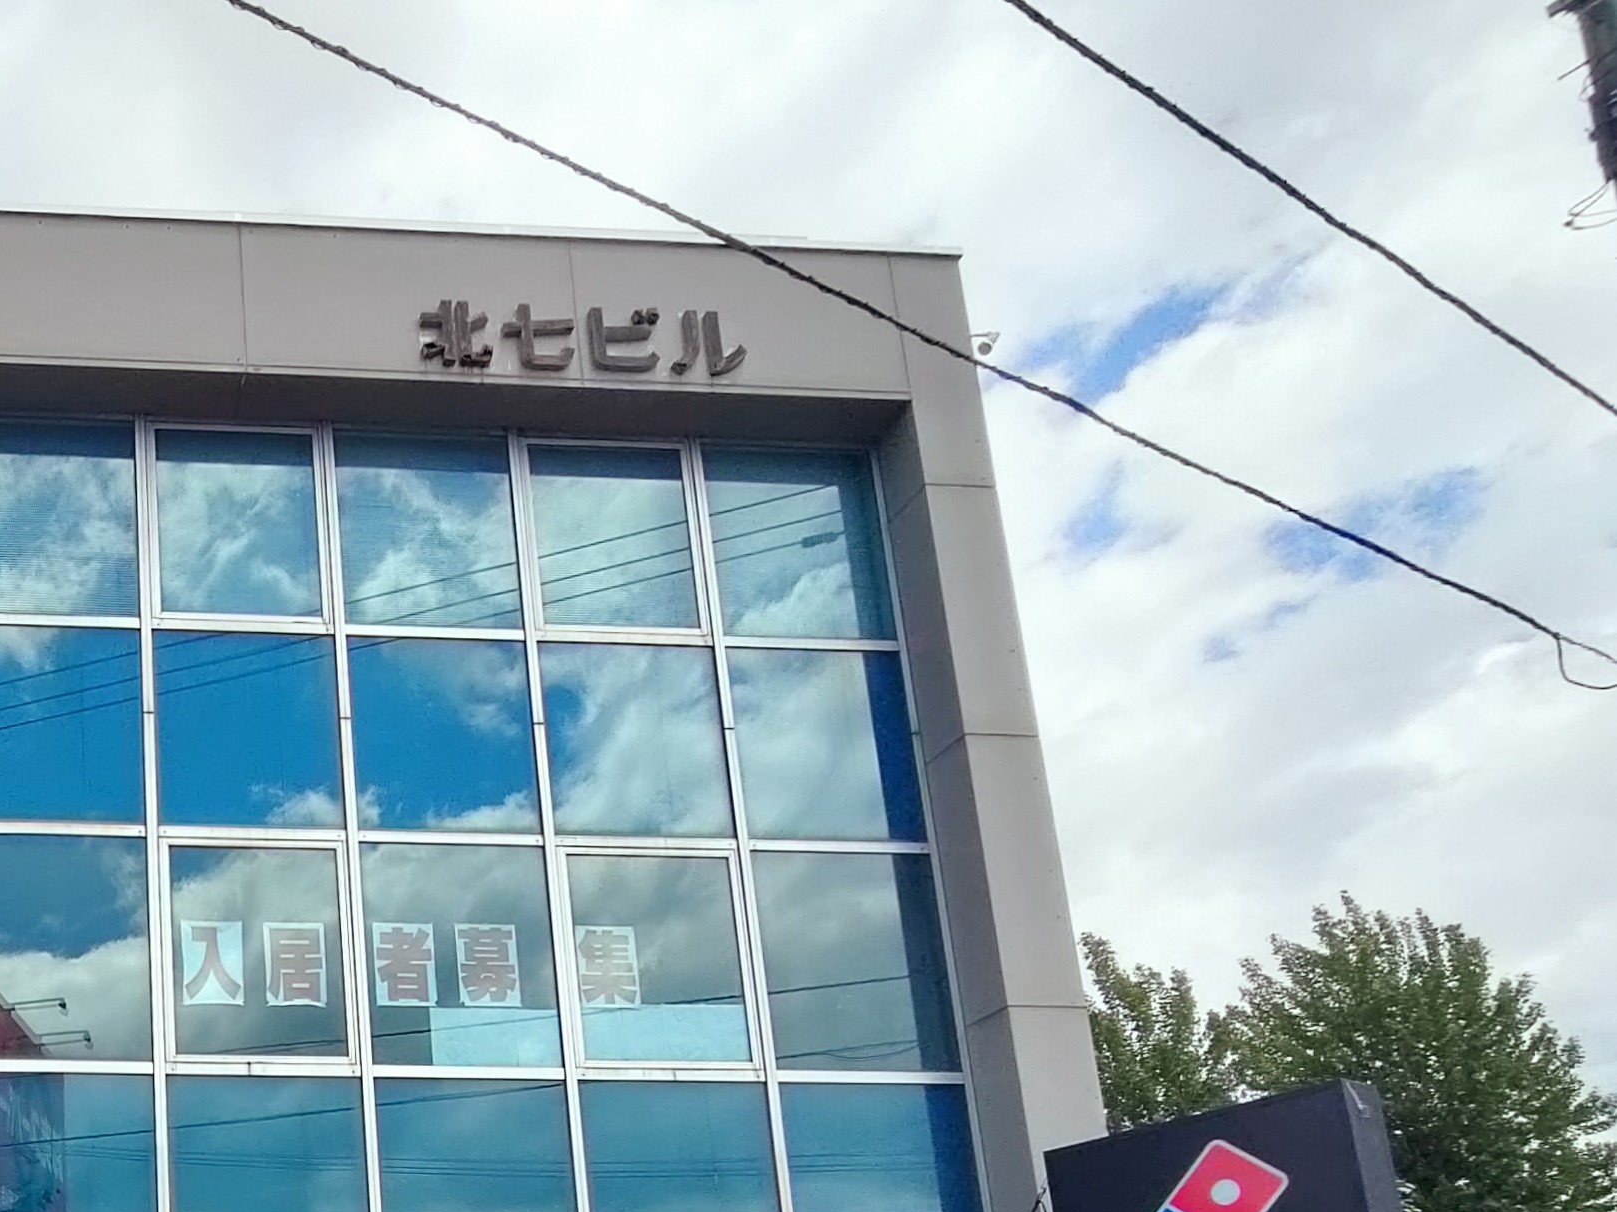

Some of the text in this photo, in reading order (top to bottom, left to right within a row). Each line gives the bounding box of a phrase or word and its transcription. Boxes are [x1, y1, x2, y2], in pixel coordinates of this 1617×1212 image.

[419, 300, 747, 377] 北七ビル
[185, 925, 638, 1003] 入居者募集
